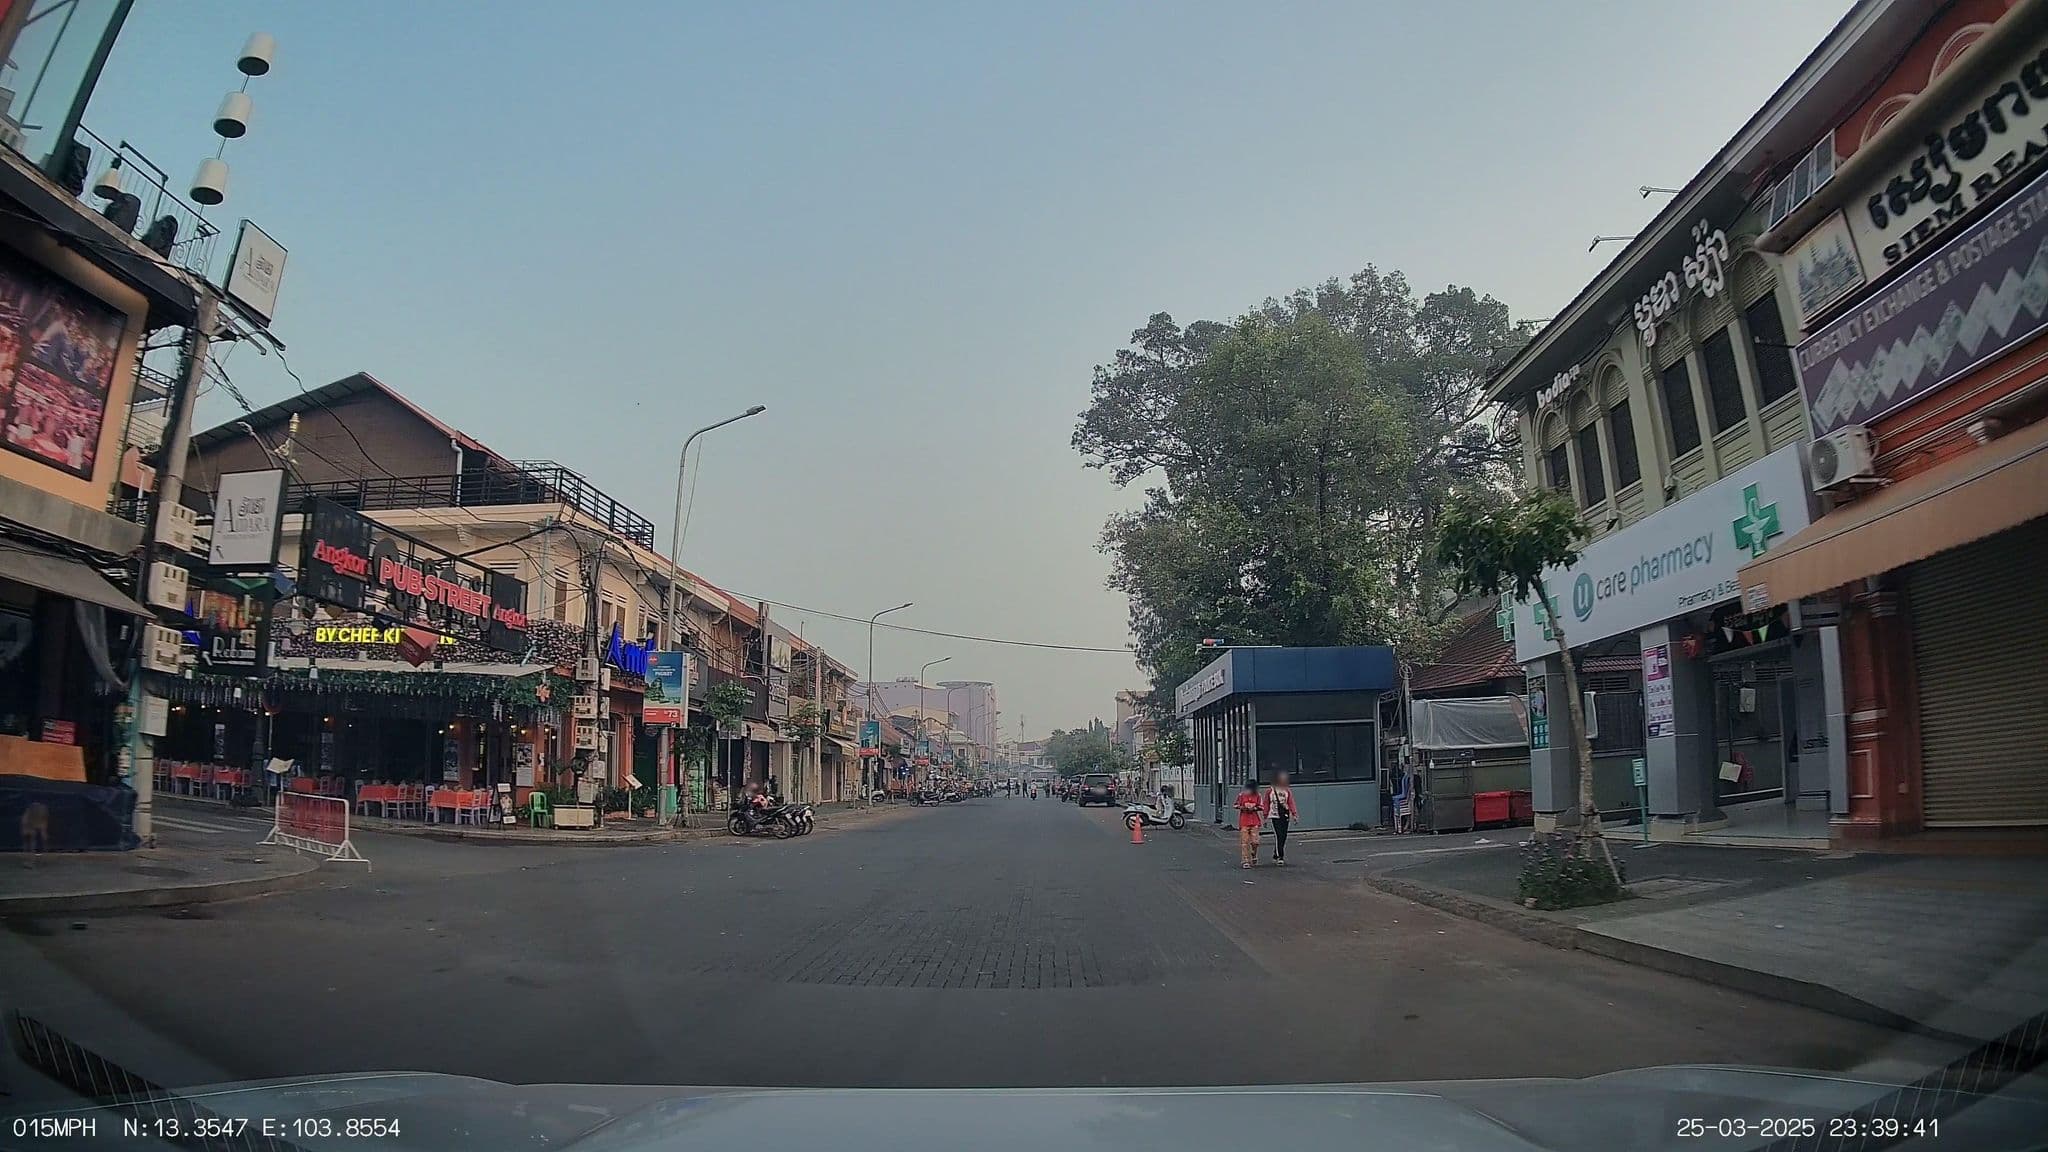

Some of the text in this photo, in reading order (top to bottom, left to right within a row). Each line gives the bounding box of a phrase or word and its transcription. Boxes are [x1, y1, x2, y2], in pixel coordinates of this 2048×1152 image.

[1883, 123, 2048, 266] SIEM REA
[1800, 314, 1864, 372] CURRENCY
[1863, 267, 1938, 334] EXCHANGE
[1933, 259, 1951, 285] &
[1950, 211, 2021, 278] POSTAGE
[1536, 372, 1571, 409] bodia
[313, 539, 368, 575] Angkor
[1596, 569, 1627, 601] care
[1631, 530, 1714, 595] pharmacy
[379, 556, 492, 619] PUB STREET
[1678, 587, 1716, 609] Pharmacy
[1717, 582, 1726, 597] &
[492, 603, 528, 630] Angkor
[316, 628, 336, 643] BY
